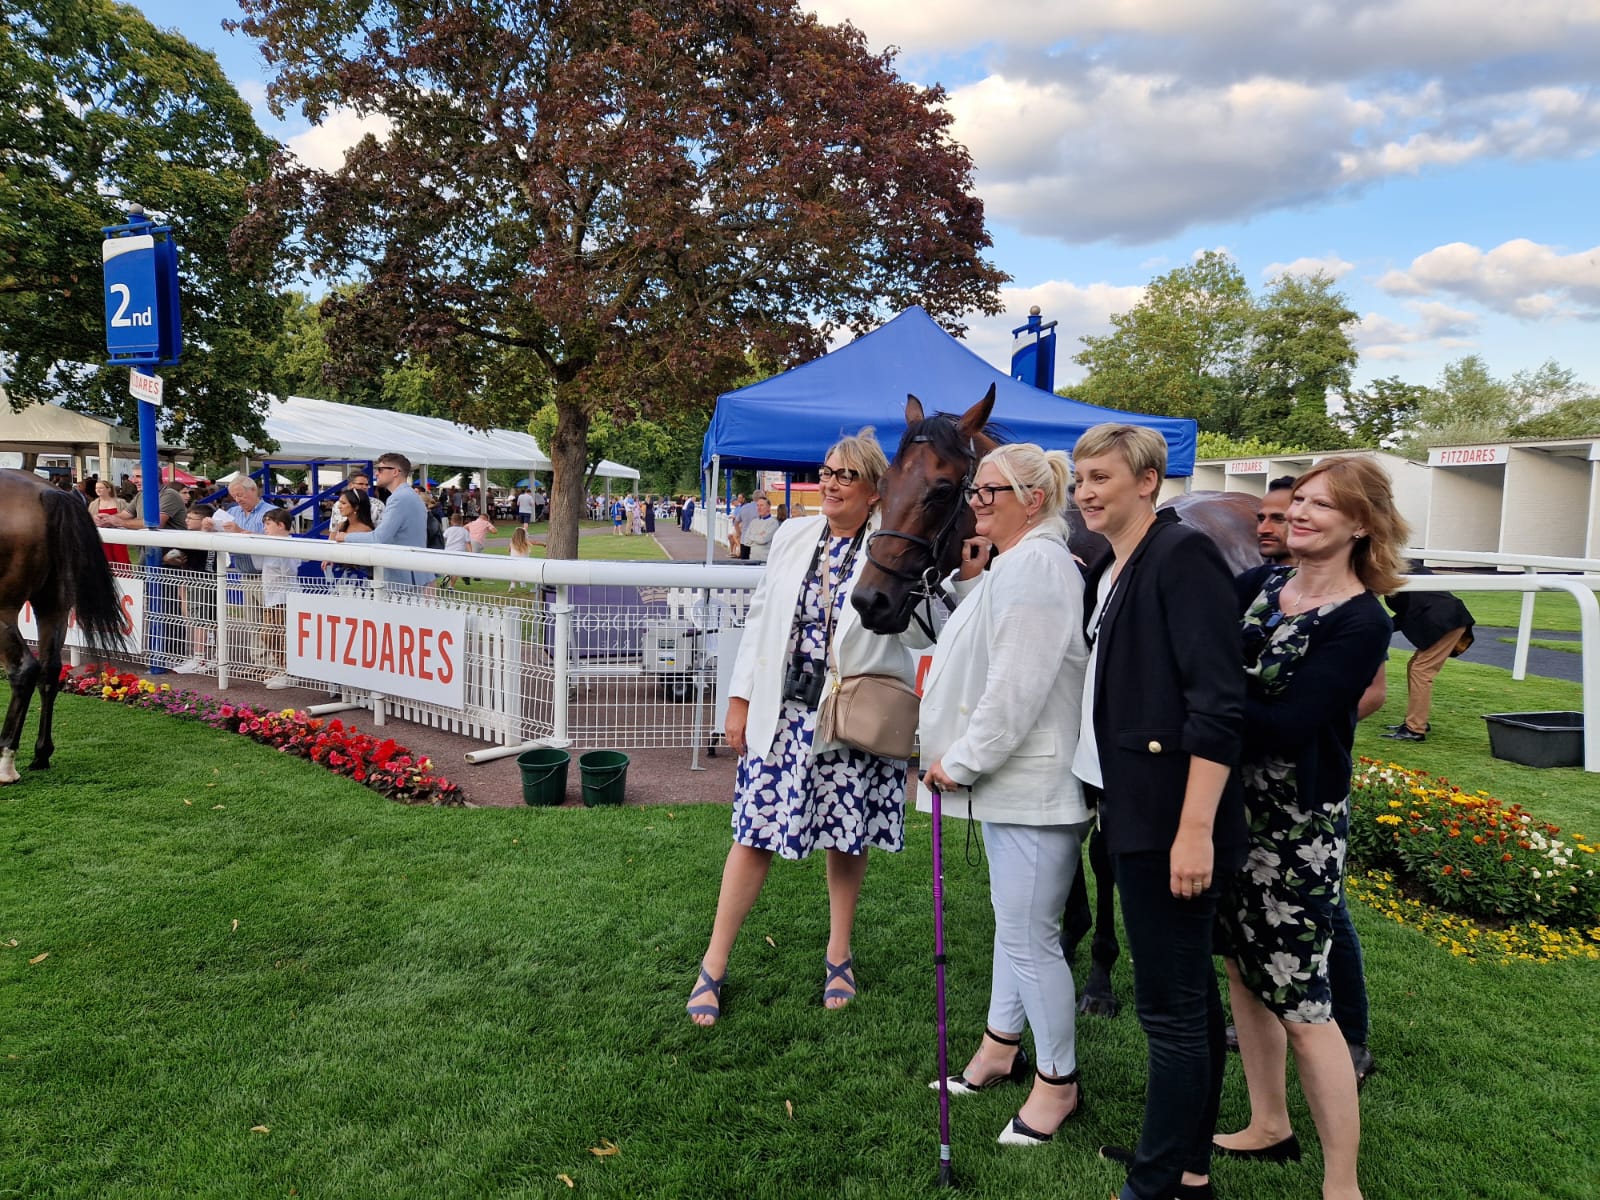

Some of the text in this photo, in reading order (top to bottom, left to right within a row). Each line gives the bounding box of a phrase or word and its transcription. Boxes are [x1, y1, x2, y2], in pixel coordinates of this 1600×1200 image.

[110, 283, 152, 327] 2nd
[1231, 460, 1263, 473] FITZDARES
[1440, 447, 1496, 464] FITZDARES
[297, 611, 454, 684] FITZDARES
